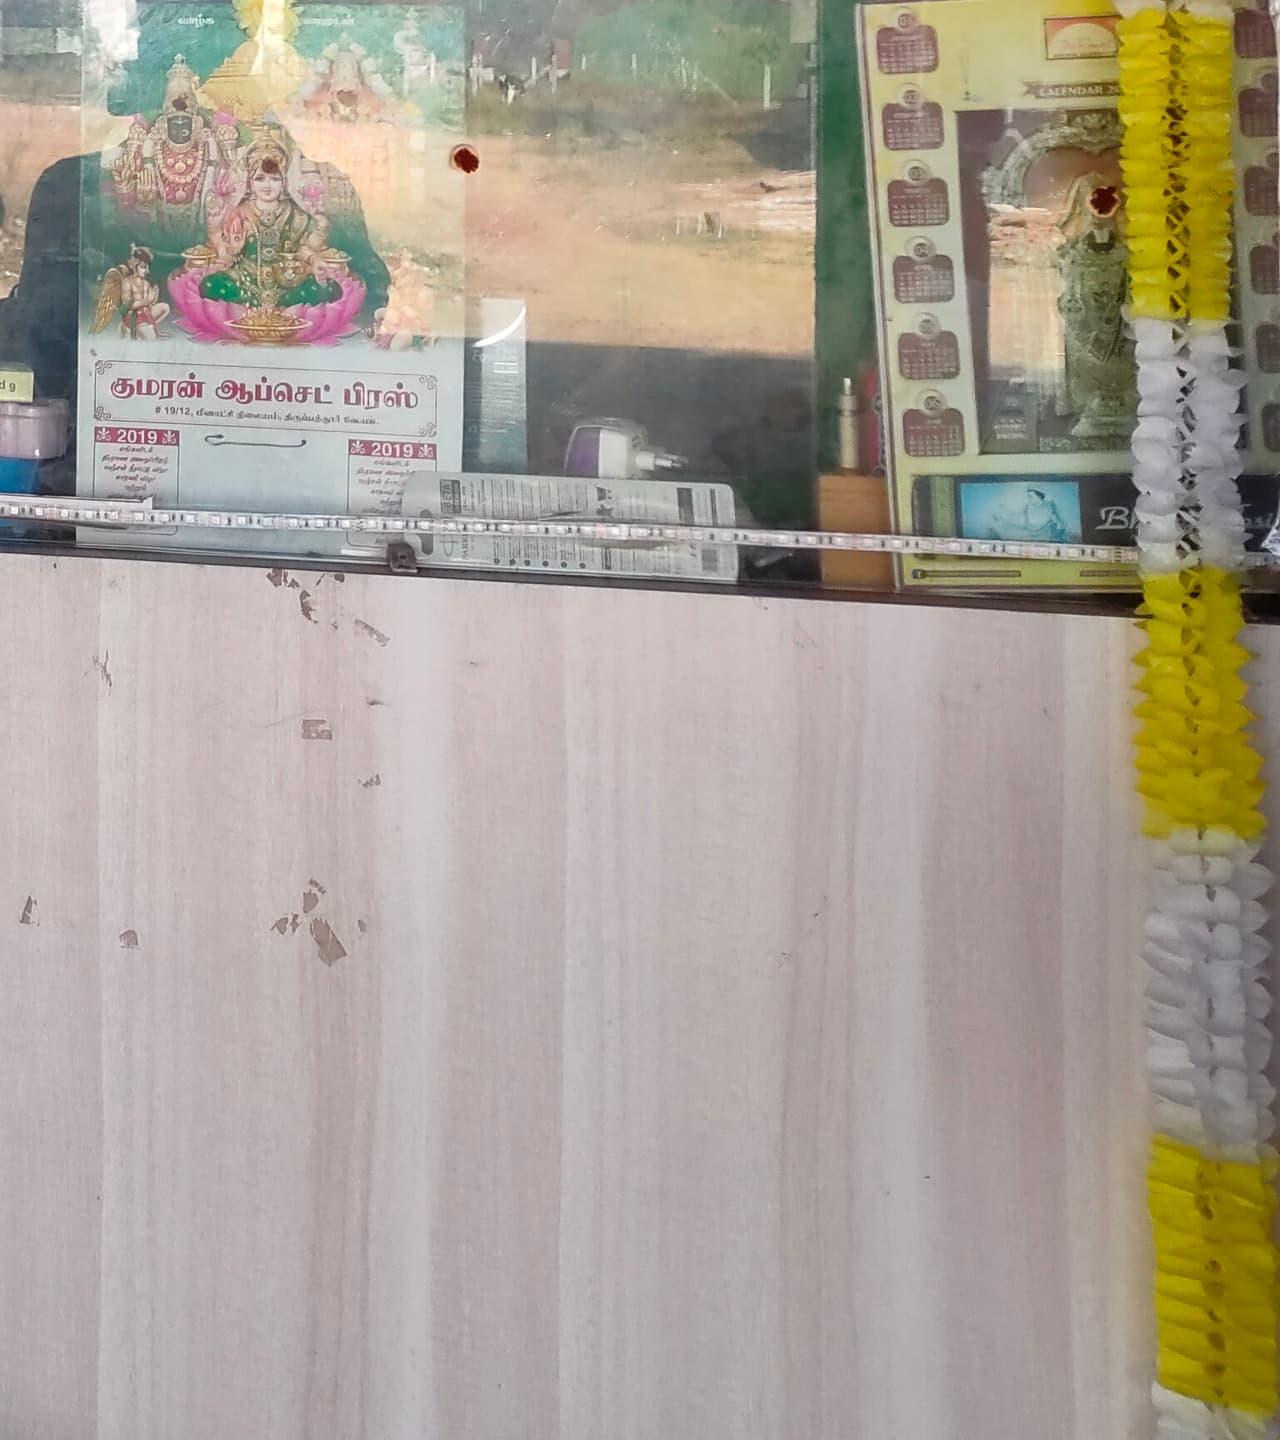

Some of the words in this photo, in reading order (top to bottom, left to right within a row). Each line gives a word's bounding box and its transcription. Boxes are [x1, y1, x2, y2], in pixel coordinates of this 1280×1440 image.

[8, 382, 17, 393] 6
[110, 371, 206, 401] குமரன்
[215, 376, 334, 406] ஆப்செட்
[343, 382, 420, 412] பிரஸ்
[116, 428, 158, 445] 2019
[371, 442, 414, 458] 2019
